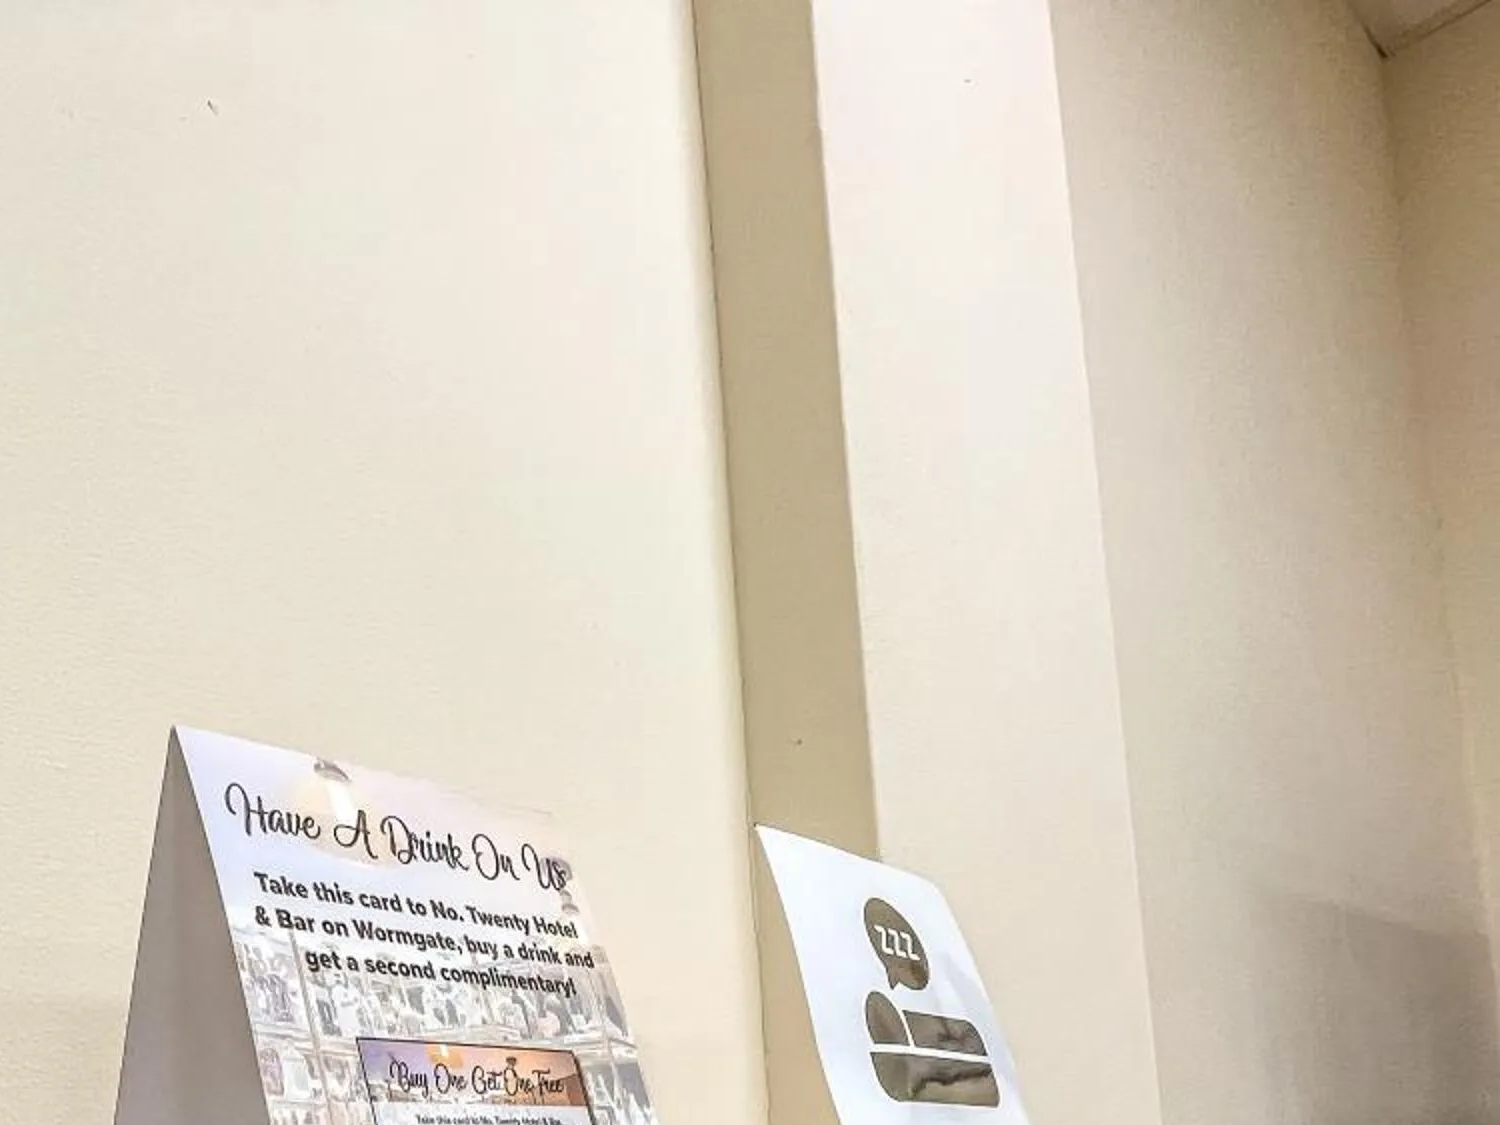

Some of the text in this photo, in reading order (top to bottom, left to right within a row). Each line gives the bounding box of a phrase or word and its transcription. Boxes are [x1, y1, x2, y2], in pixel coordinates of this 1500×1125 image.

[224, 782, 567, 890] Have A Drink On Us
[254, 871, 579, 939] Take this card to No. Twenty Hotel
[255, 905, 595, 969] & Bar on Wormgate, buy a drink and
[305, 950, 578, 999] get a second complimentary!
[389, 1060, 429, 1098] Buy
[433, 1063, 467, 1095] One
[471, 1065, 503, 1095] Get
[531, 1069, 564, 1096] Free
